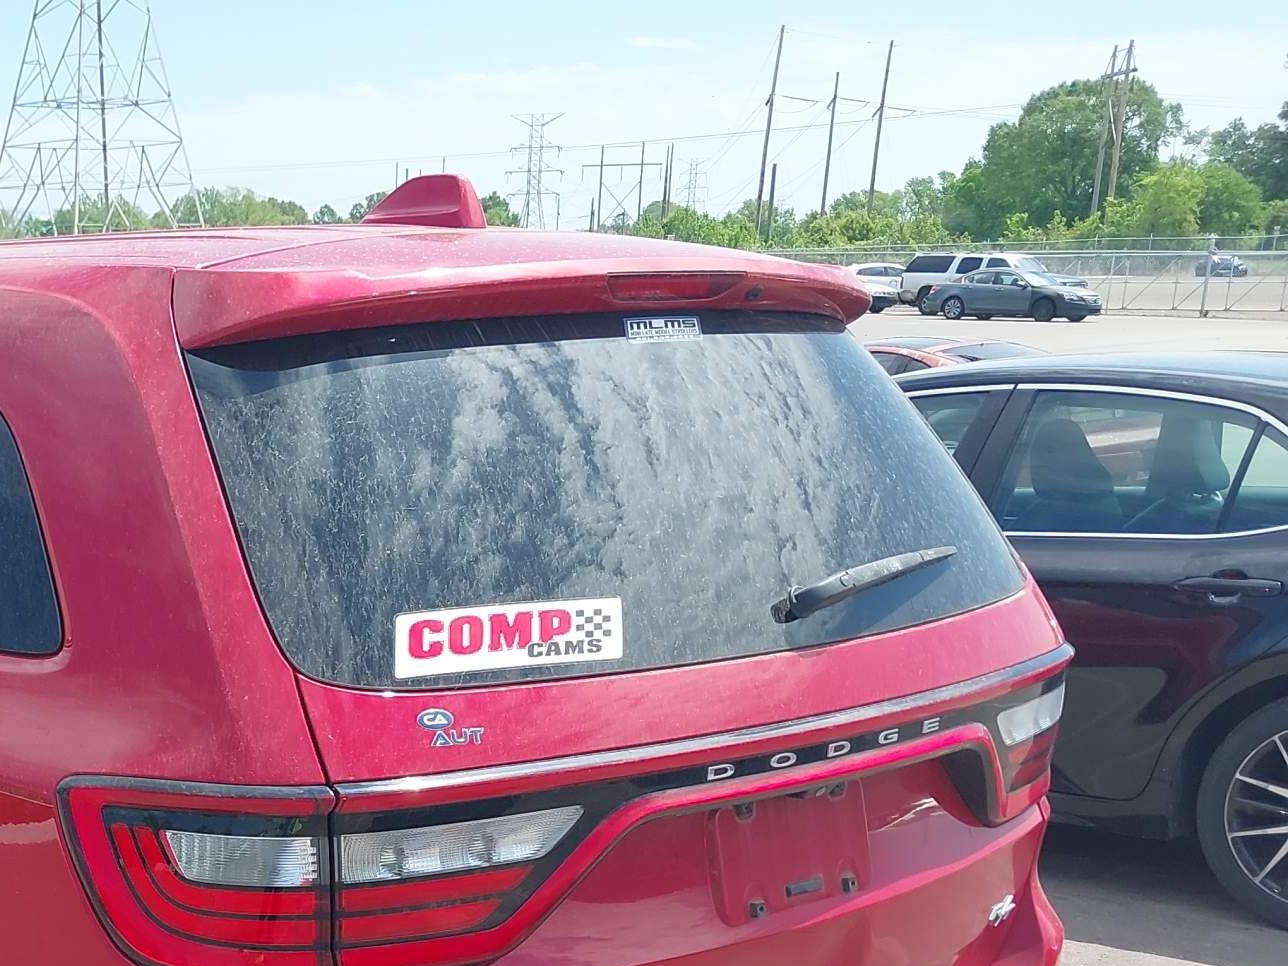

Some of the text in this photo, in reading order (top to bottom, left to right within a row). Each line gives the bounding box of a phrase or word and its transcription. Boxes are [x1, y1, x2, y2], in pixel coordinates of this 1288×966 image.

[629, 319, 696, 330] MLMS
[408, 609, 571, 660] COMP
[527, 638, 602, 658] CAMS
[706, 717, 941, 782] DODGE
